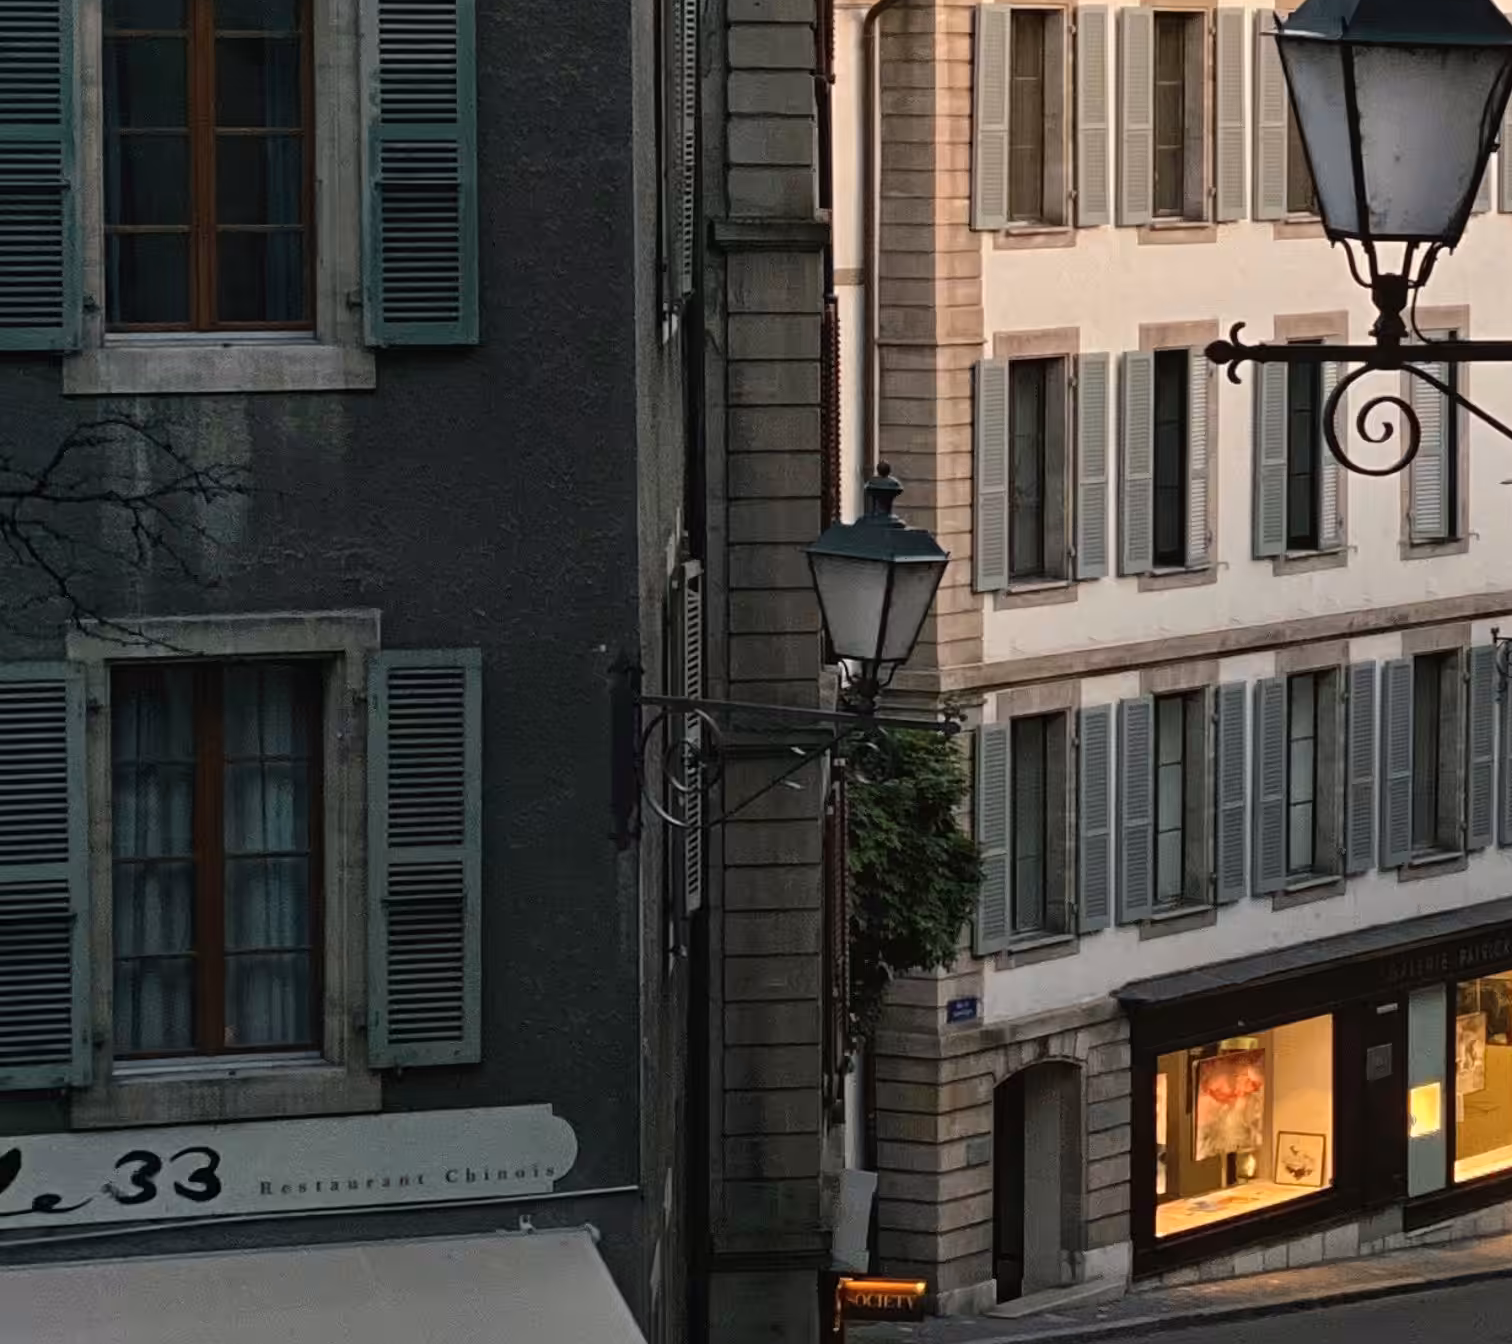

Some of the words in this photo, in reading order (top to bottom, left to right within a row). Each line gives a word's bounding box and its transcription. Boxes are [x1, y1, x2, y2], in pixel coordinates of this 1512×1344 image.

[103, 1145, 222, 1206] 33
[259, 1175, 424, 1195] Restaurant
[444, 1163, 555, 1184] Chinois
[846, 1293, 917, 1311] SOCIETY
